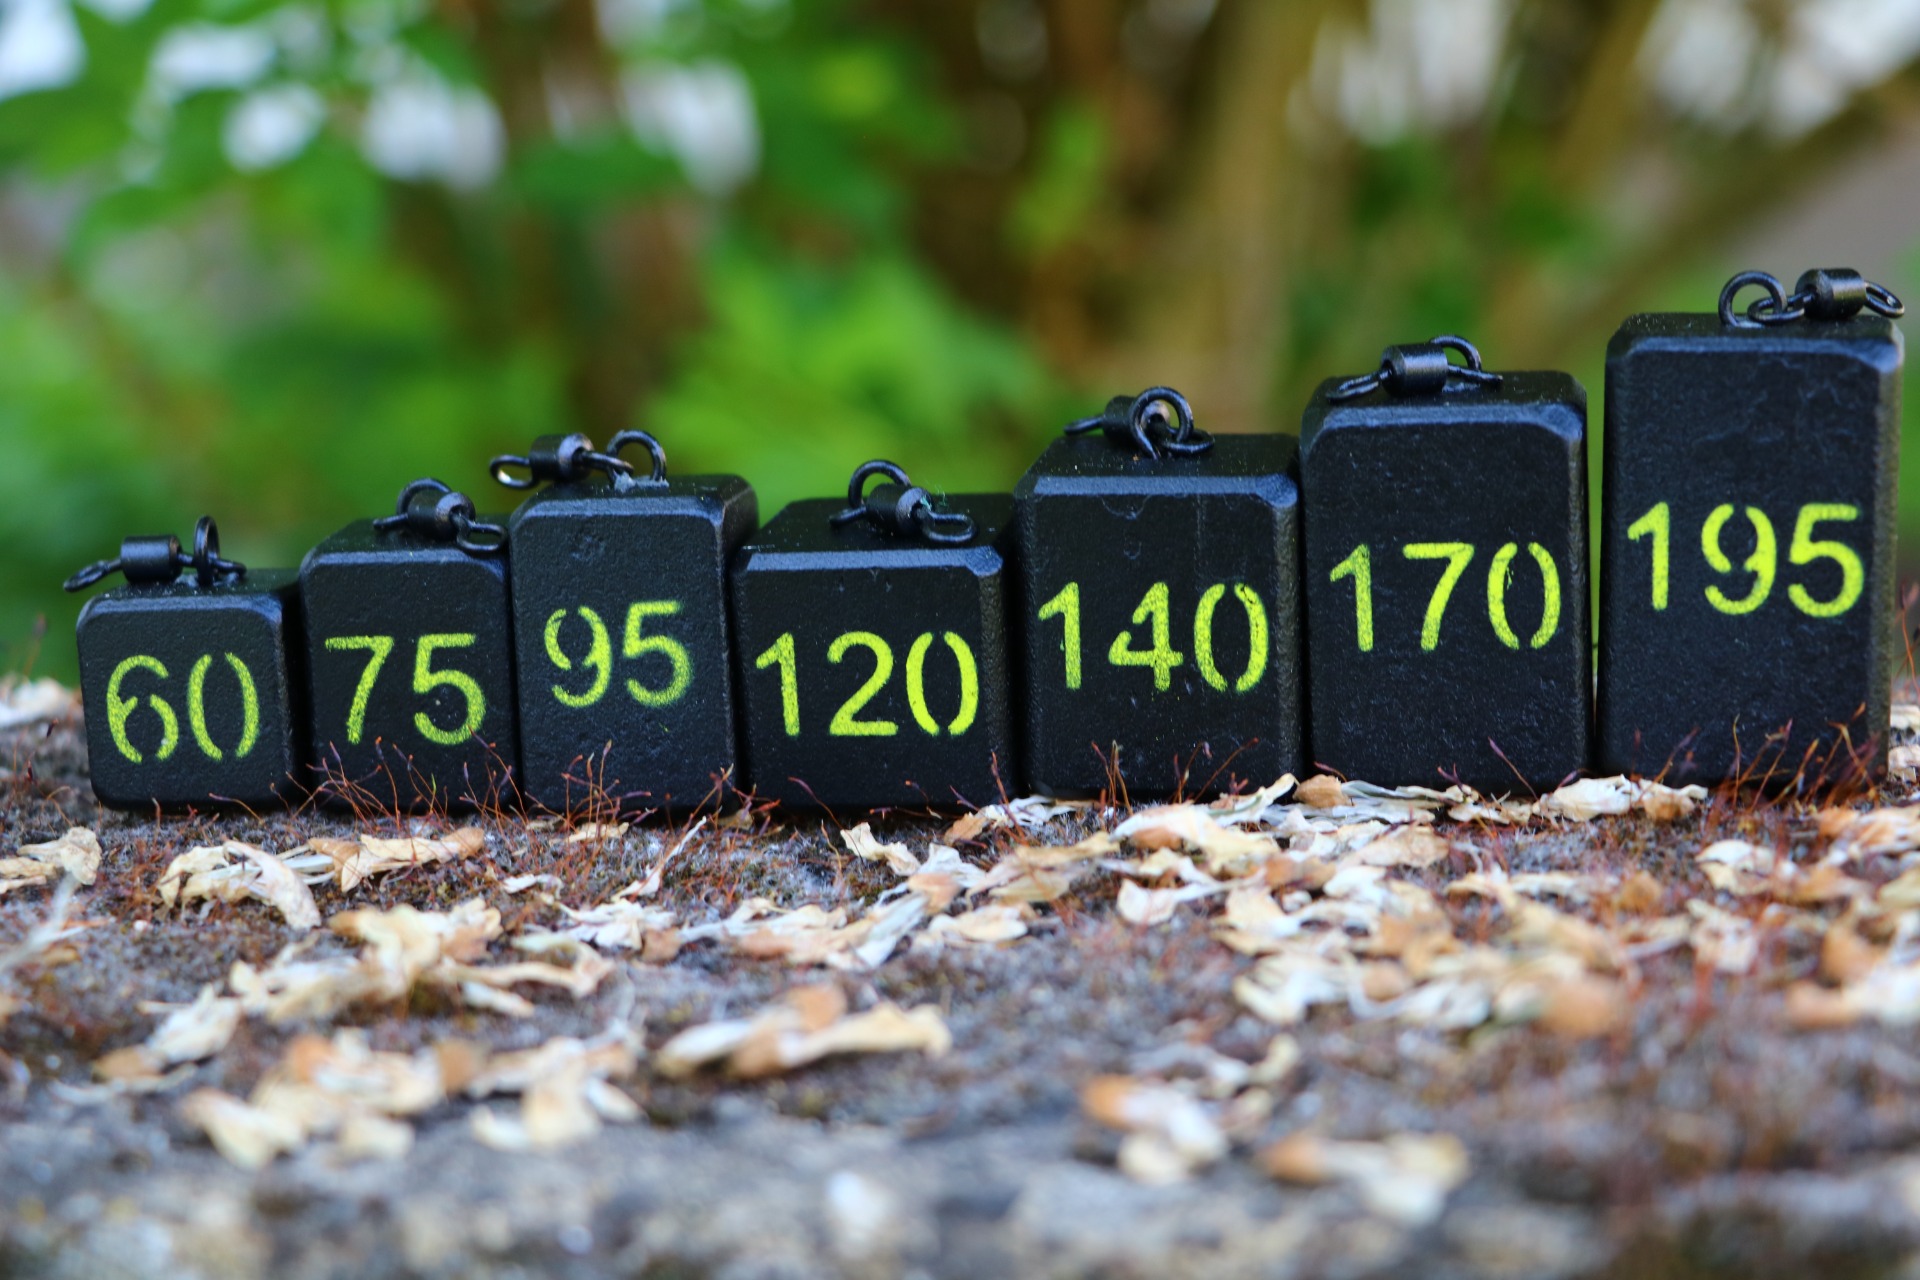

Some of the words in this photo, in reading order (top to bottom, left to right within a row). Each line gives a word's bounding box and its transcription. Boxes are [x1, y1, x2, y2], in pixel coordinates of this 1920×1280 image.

[1330, 541, 1561, 651] 170
[1628, 503, 1863, 617] 195
[325, 633, 486, 744] 75
[544, 600, 691, 707] 95
[756, 632, 979, 735] 120
[1038, 582, 1268, 691] 140
[107, 653, 259, 761] 60
